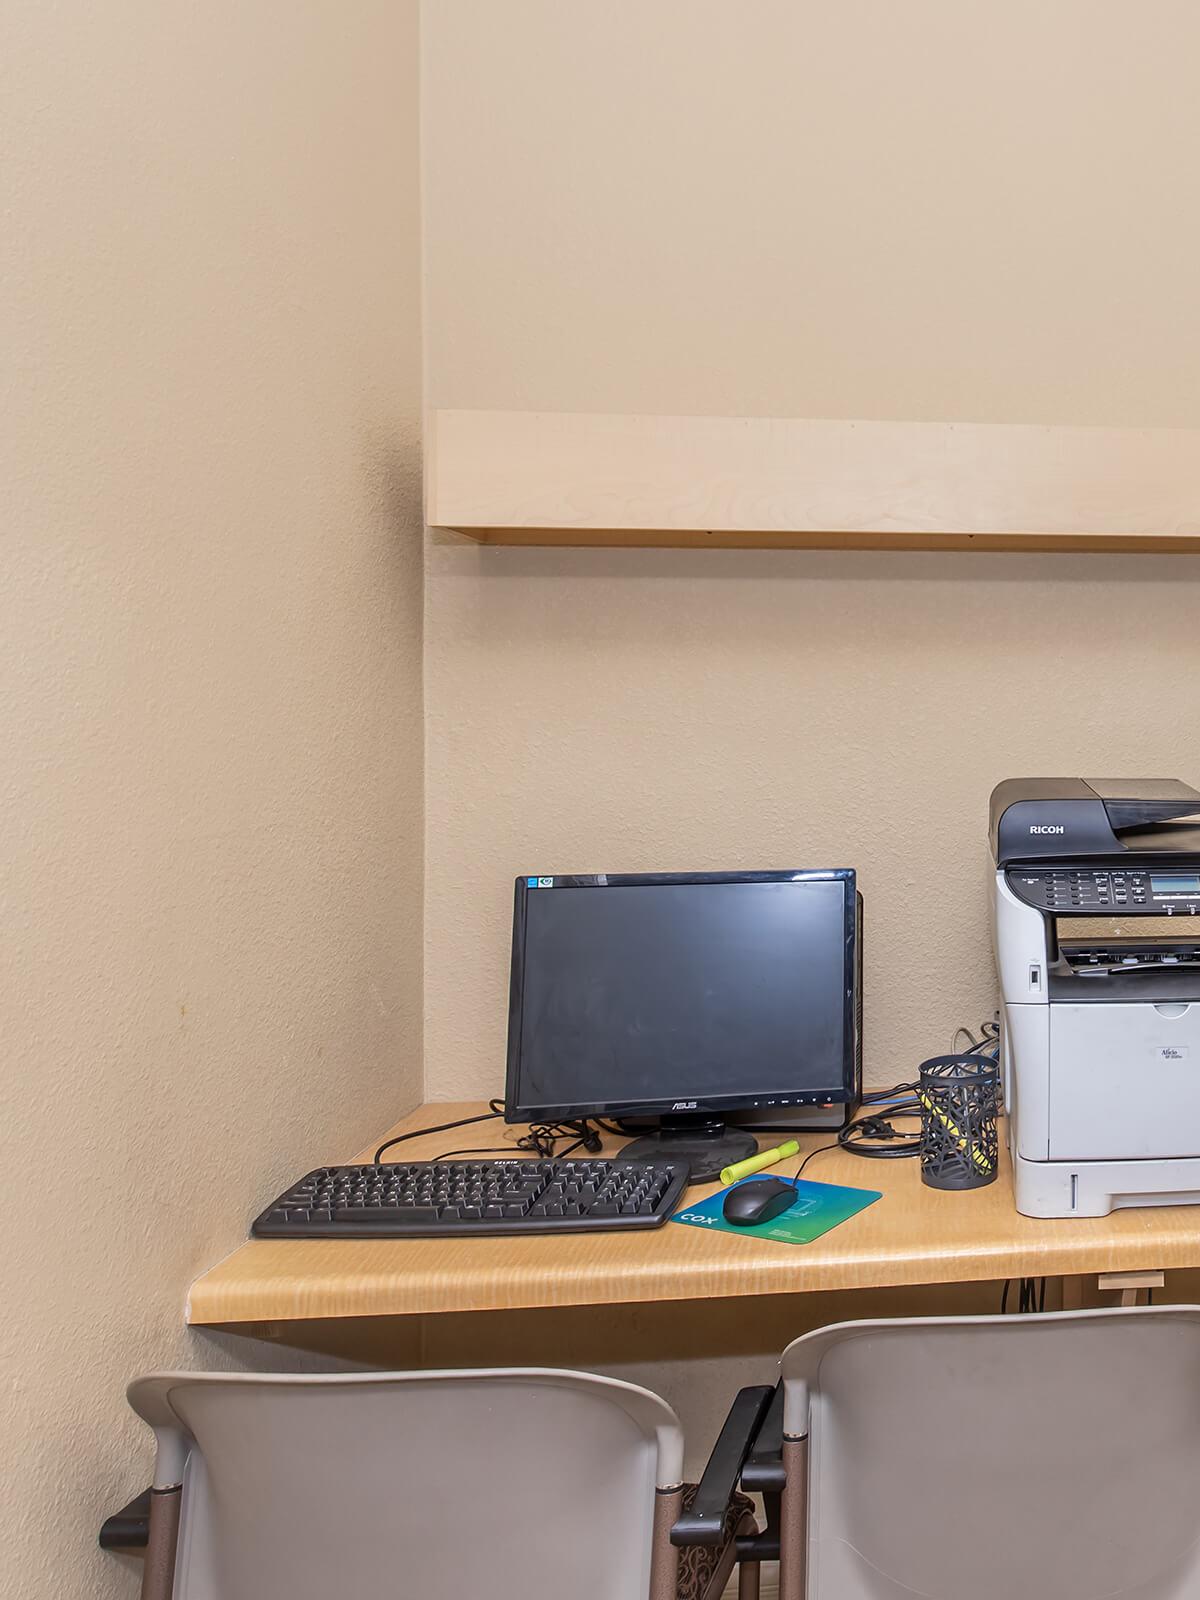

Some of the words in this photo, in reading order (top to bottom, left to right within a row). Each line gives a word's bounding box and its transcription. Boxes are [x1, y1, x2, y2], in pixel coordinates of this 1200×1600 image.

[1030, 825, 1064, 834] RICOH
[672, 1101, 697, 1110] ASUS
[680, 1213, 719, 1225] COX
